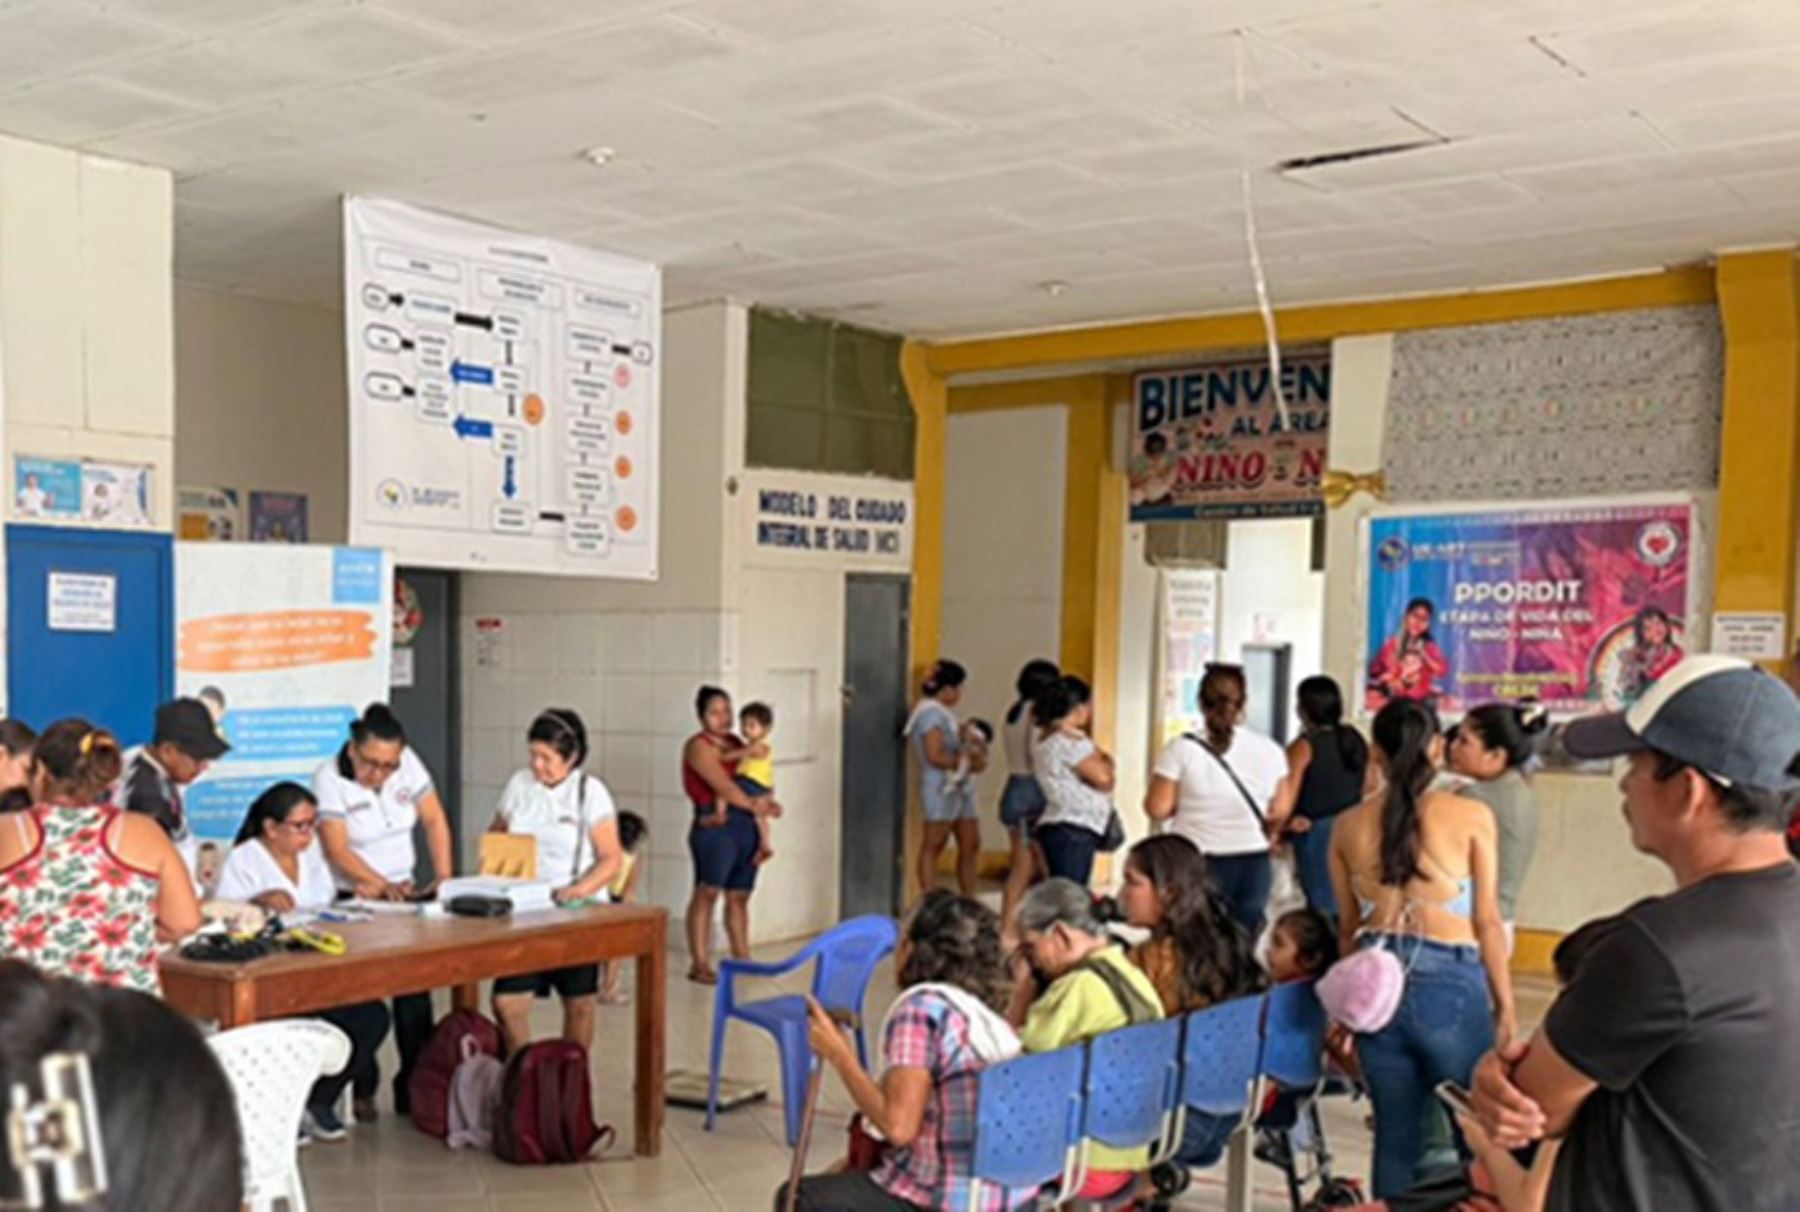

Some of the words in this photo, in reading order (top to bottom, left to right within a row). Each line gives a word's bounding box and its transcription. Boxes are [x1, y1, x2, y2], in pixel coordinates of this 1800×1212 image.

[1140, 362, 1329, 431] BIENVEN
[1231, 415, 1260, 435] AL
[759, 489, 816, 518] MODELO
[829, 496, 852, 520] DEL
[815, 527, 828, 550] DE
[1454, 579, 1582, 604] PPORDIT
